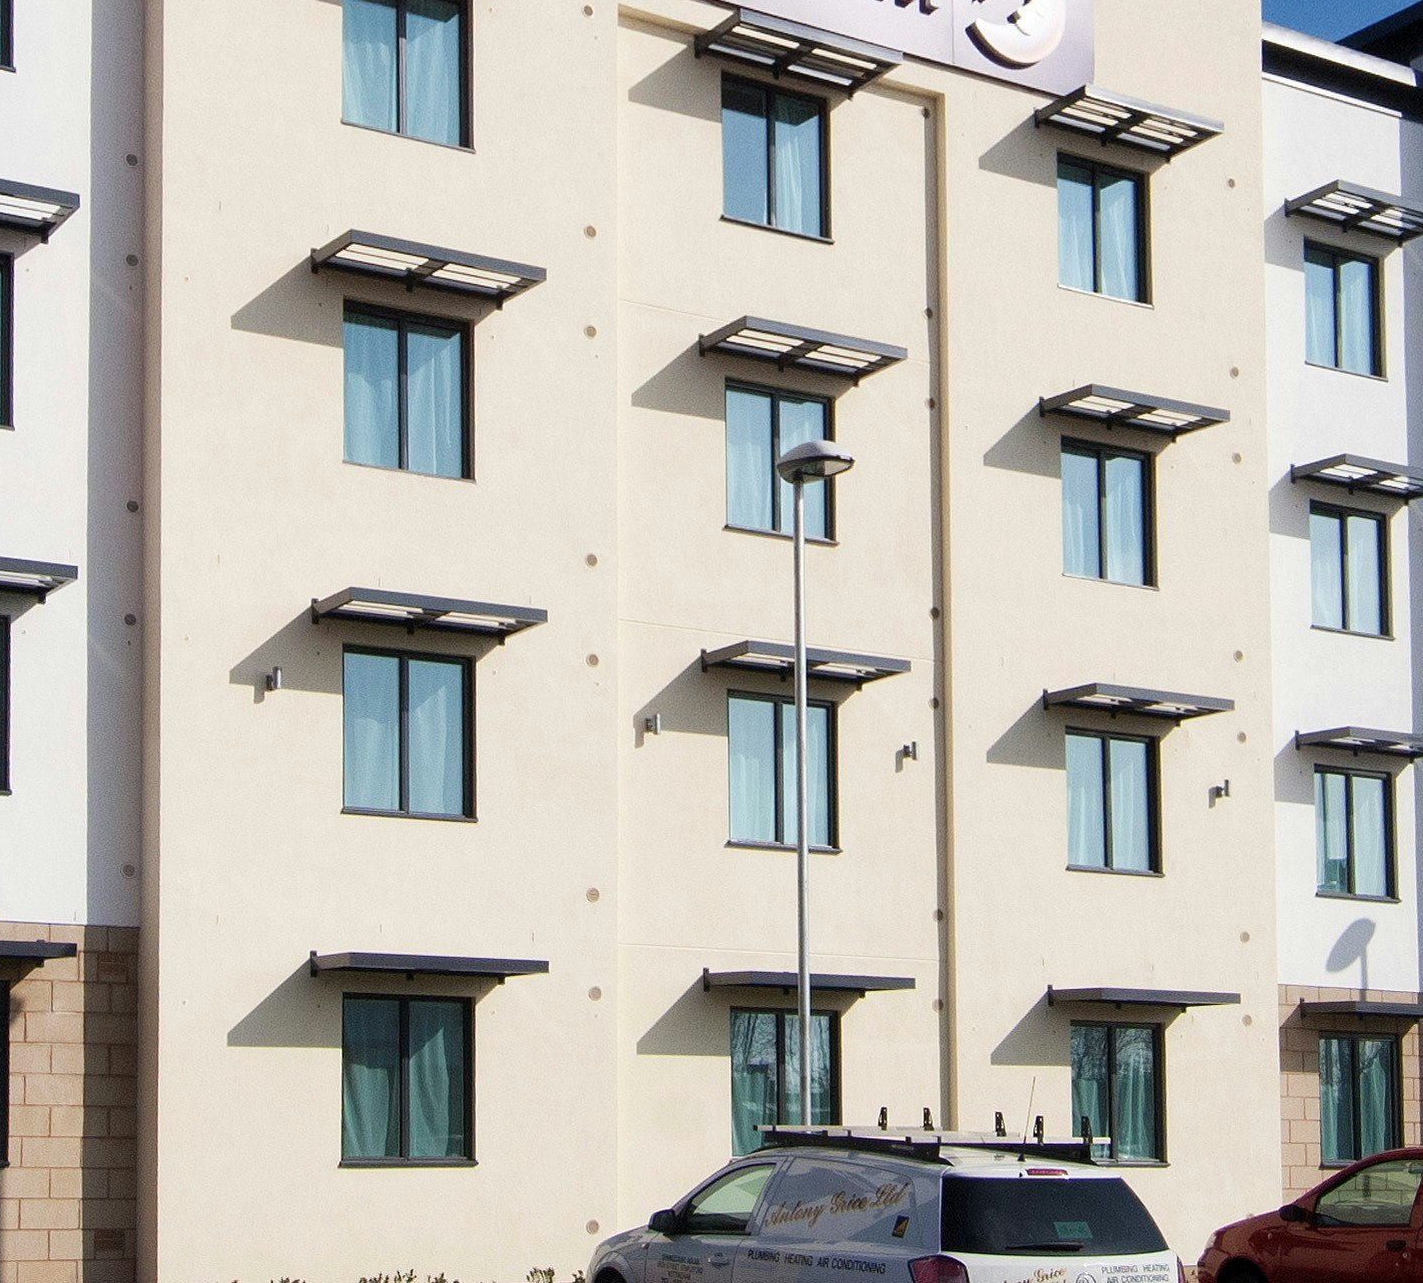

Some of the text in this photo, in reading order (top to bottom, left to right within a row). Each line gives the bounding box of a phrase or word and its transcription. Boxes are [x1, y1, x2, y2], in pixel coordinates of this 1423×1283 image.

[869, 1182, 910, 1208] Ltd
[748, 1249, 886, 1274] PLUMBING HEATING AIR CONDITIONING
[1101, 1264, 1170, 1274] PLUMBING HEATING
[1121, 1274, 1169, 1283] CONDITIONING
